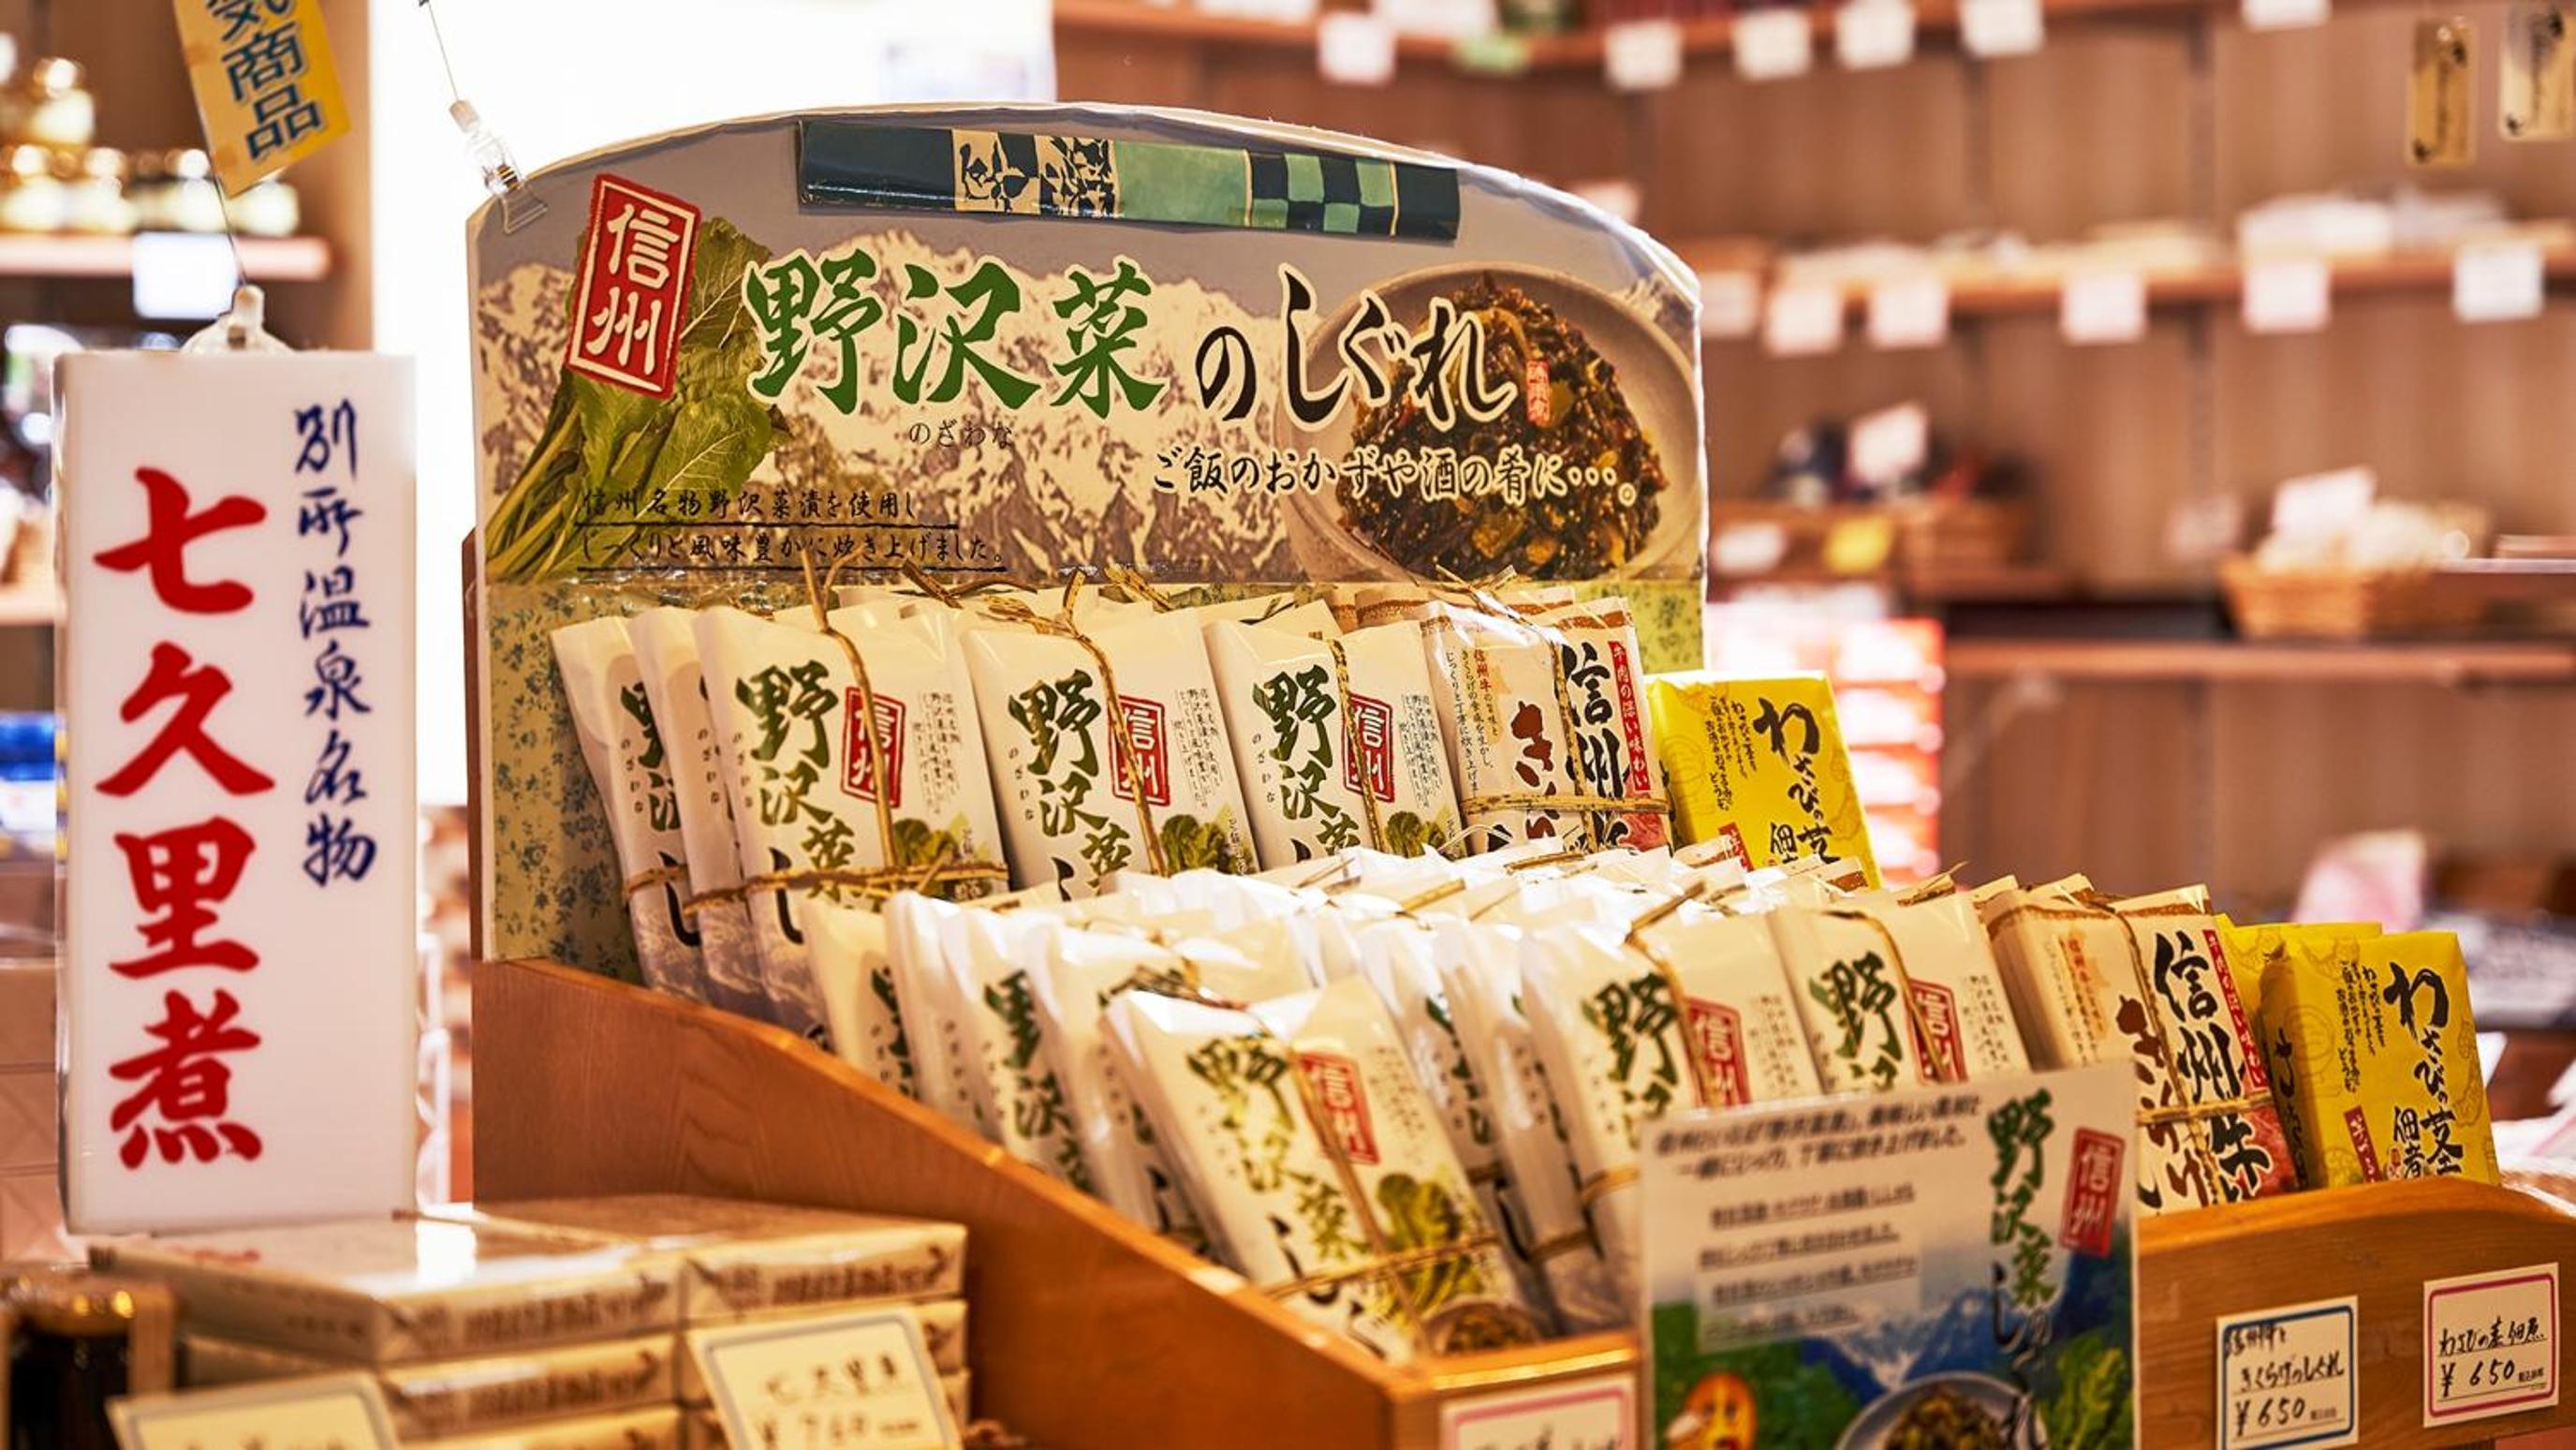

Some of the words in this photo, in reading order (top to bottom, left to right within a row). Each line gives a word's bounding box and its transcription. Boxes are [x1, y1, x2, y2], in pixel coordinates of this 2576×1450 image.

[586, 202, 680, 377] 信州
[908, 420, 1014, 449] のざわな
[293, 398, 377, 888] 別所温泉名物
[93, 466, 276, 1171] 七久里煮
